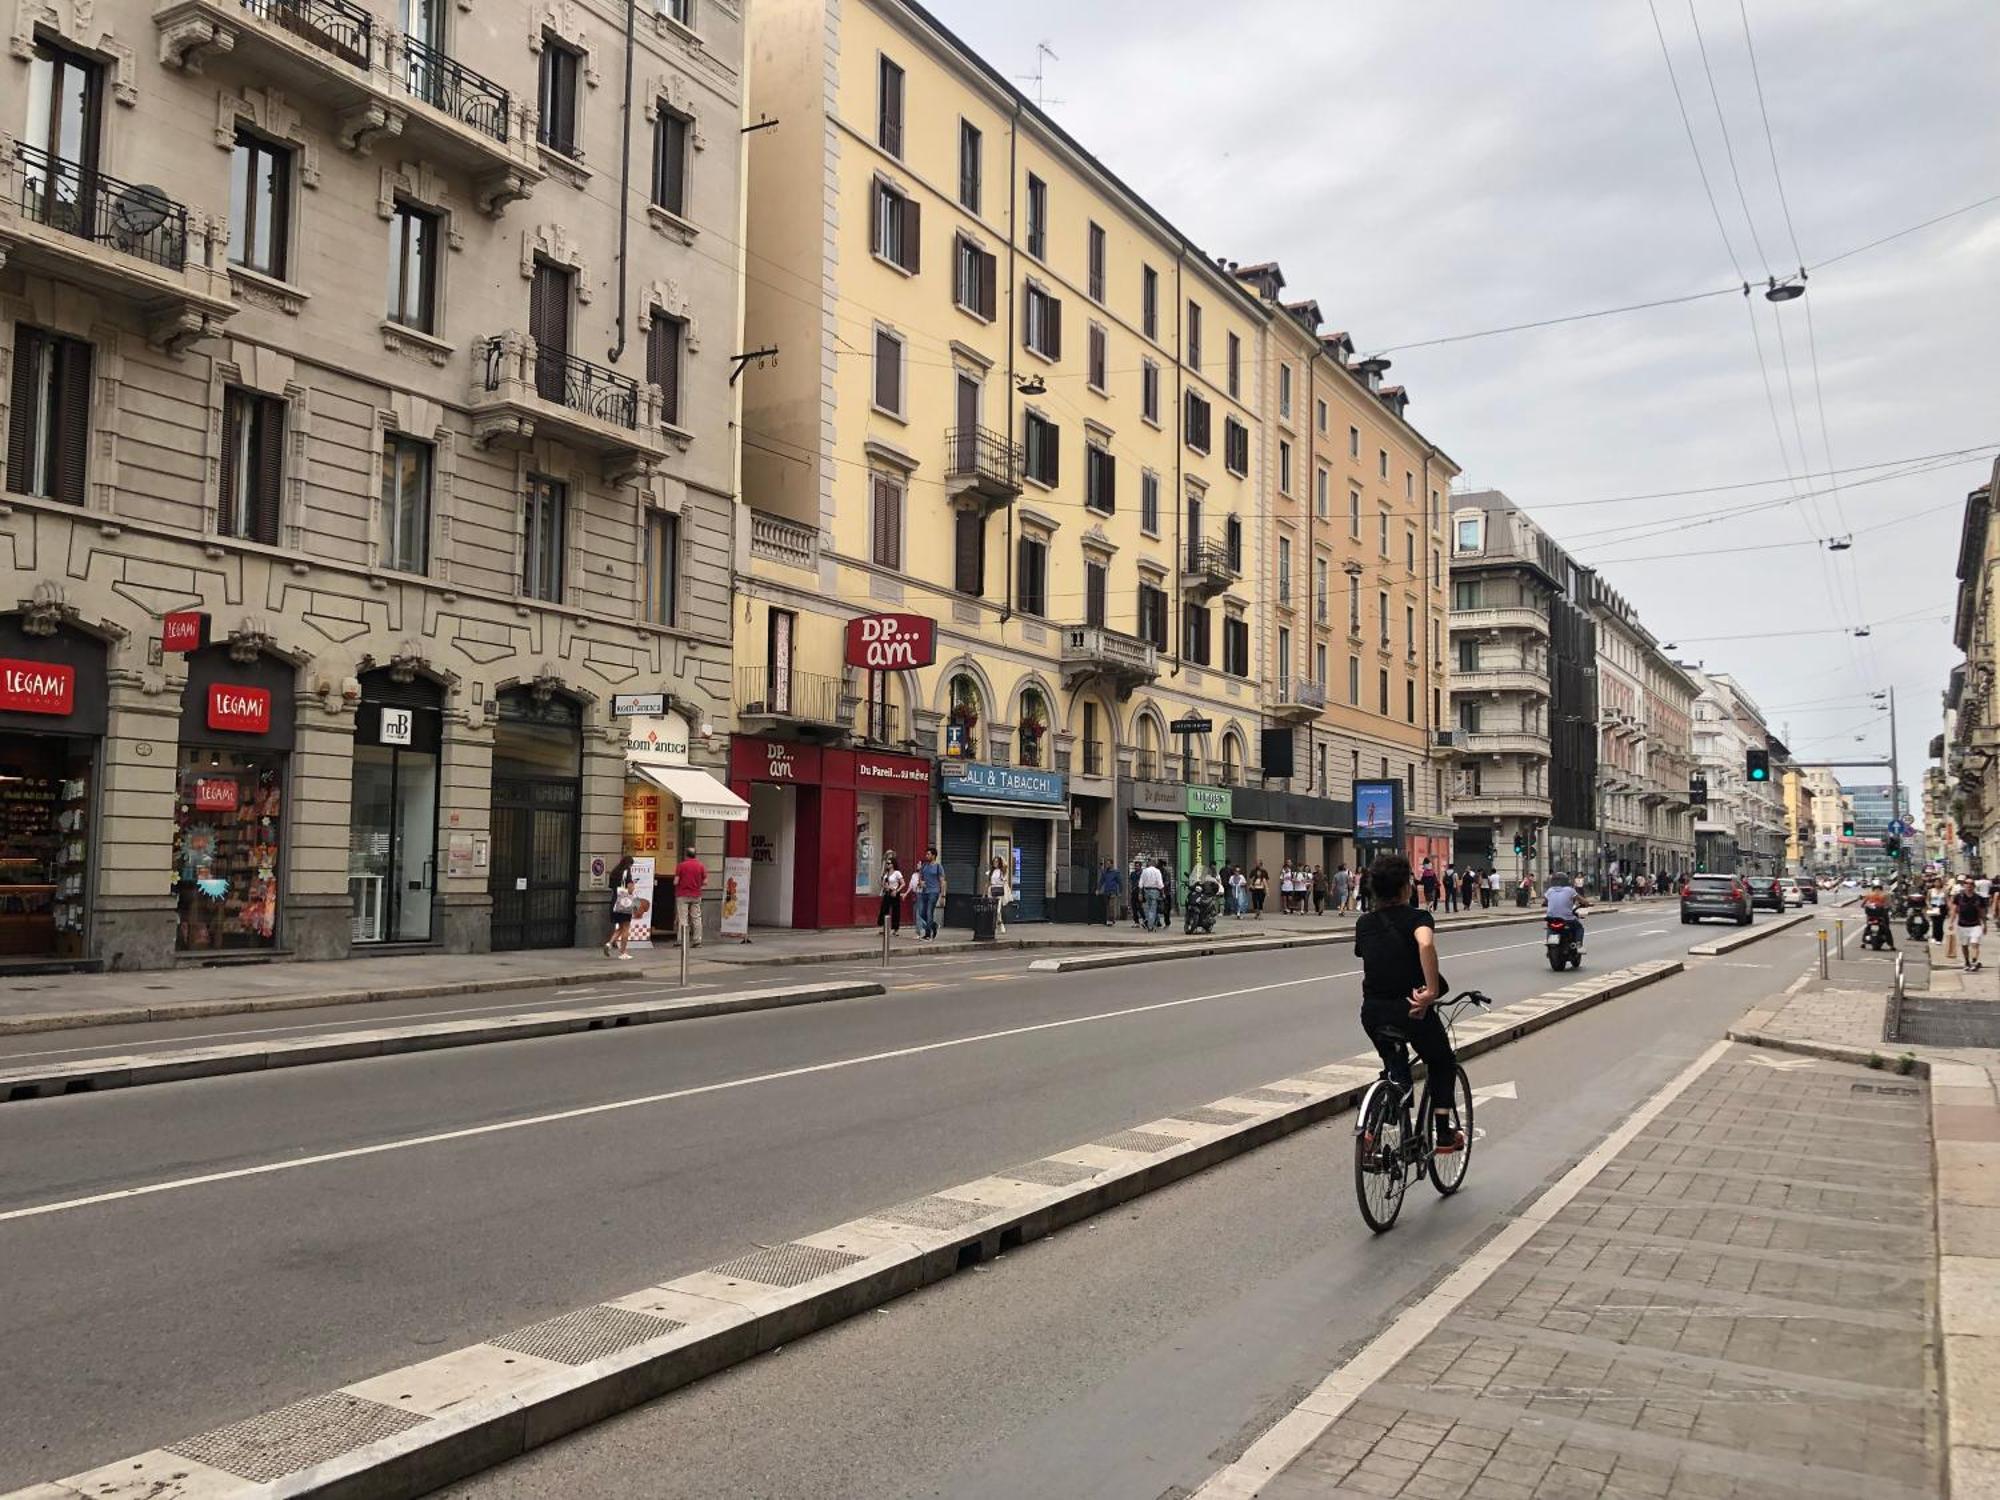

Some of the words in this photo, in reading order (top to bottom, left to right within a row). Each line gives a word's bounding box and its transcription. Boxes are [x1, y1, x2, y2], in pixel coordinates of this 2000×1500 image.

[867, 642, 917, 665] am
[769, 761, 793, 778] am
[987, 770, 996, 785] &
